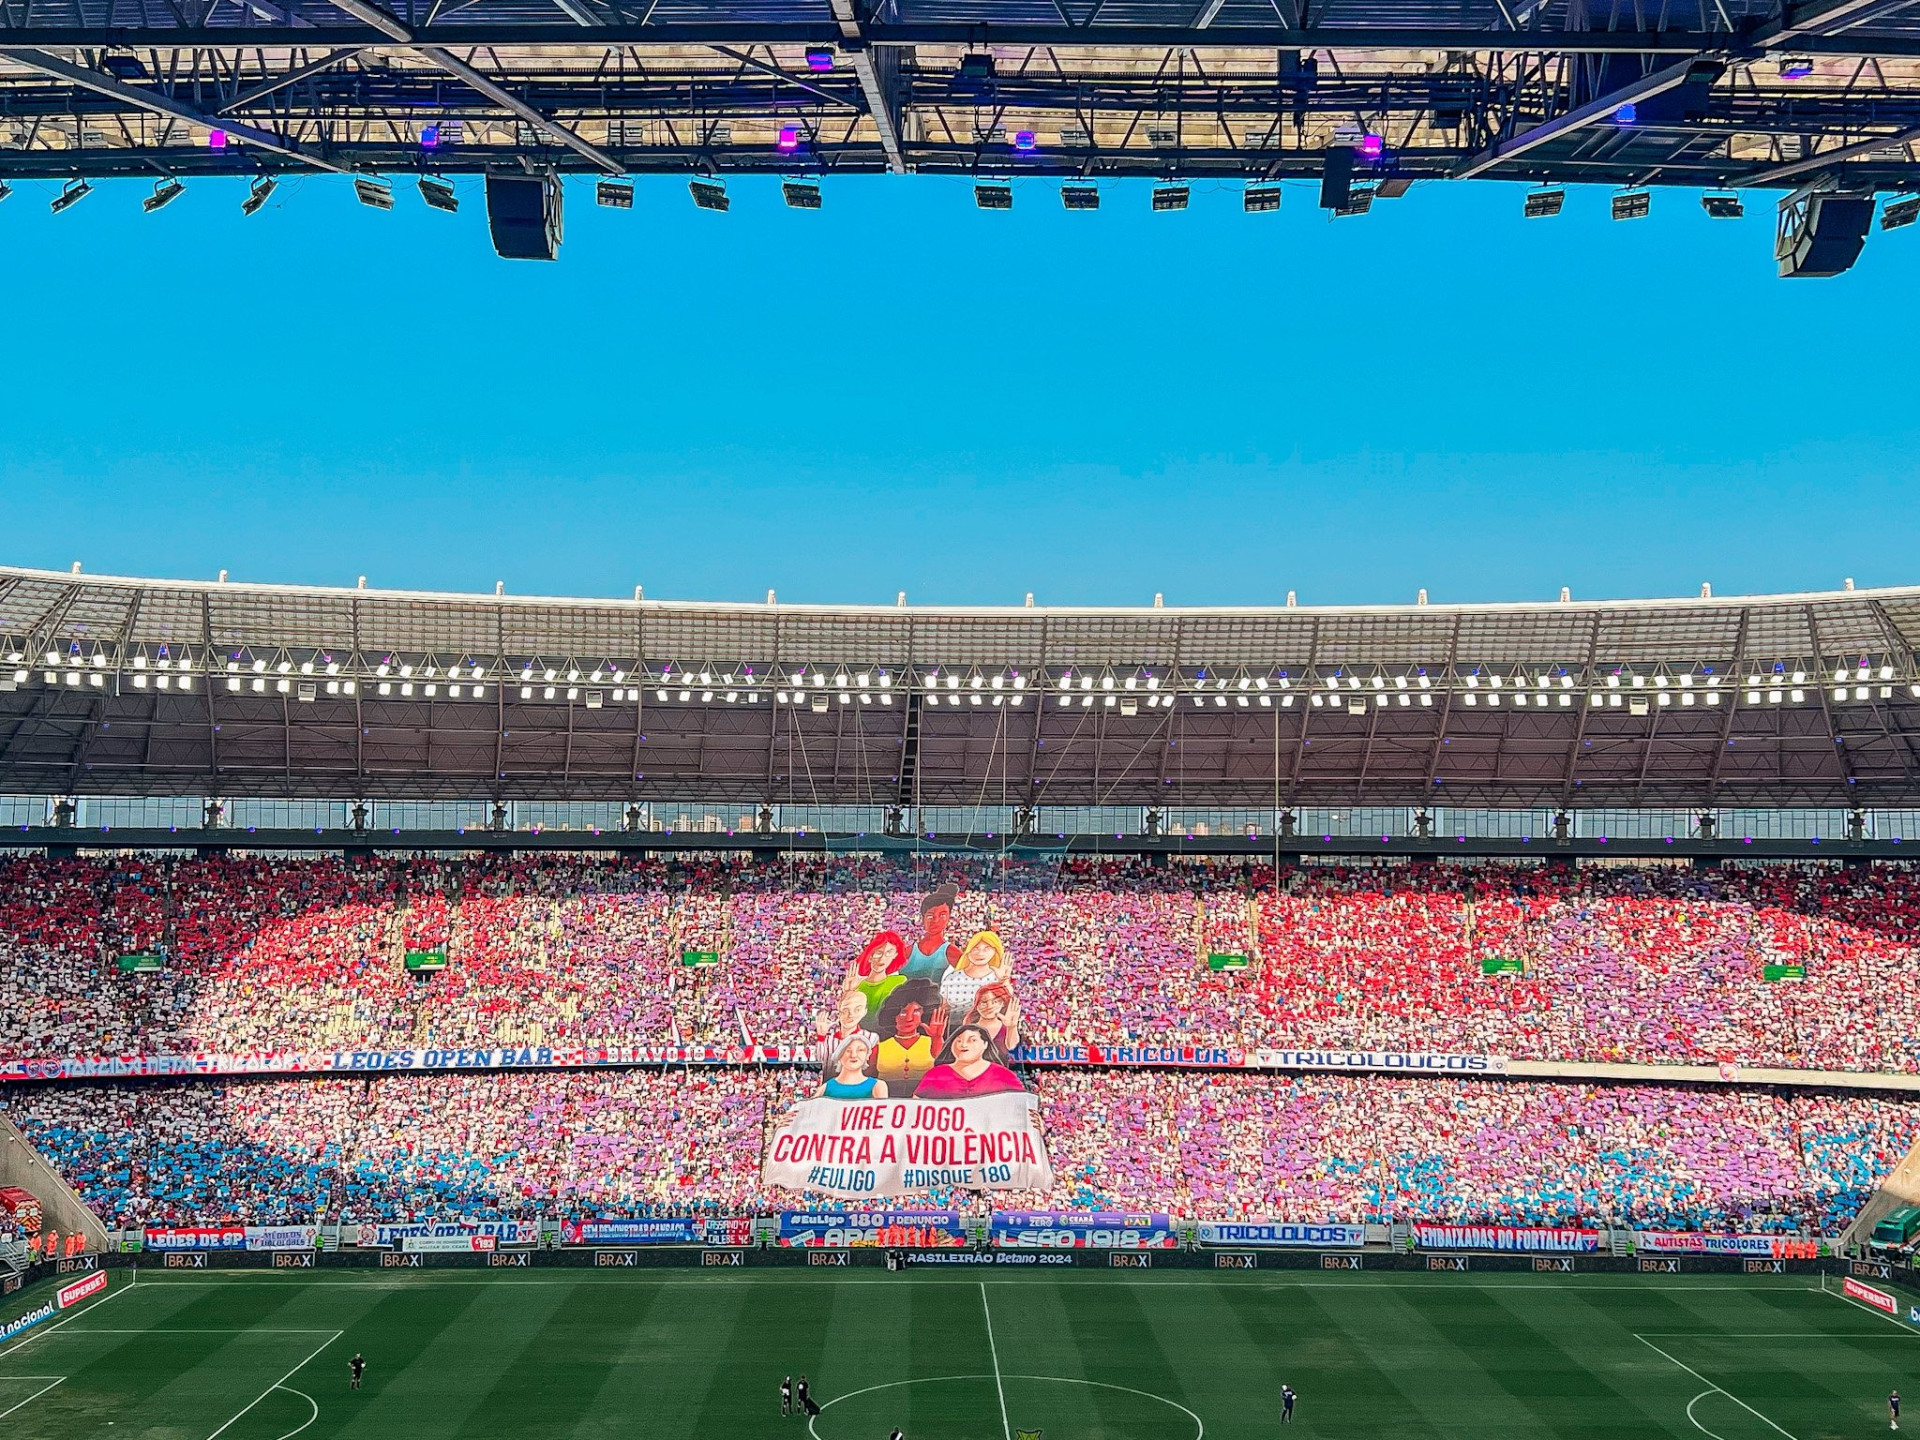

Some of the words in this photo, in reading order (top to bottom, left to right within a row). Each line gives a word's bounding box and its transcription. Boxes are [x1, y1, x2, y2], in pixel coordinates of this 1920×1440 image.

[423, 1050, 491, 1068] OPEN
[500, 1048, 553, 1066] BAR
[606, 1046, 680, 1063] BRAVO
[684, 1046, 706, 1062] 18
[1100, 1046, 1228, 1064] TRICOLOR
[1275, 1051, 1488, 1070] TRICOLOUCOS
[840, 1104, 886, 1131] VIRE
[890, 1104, 906, 1129] O
[911, 1105, 965, 1132] JOGO
[773, 1134, 871, 1164] CONTRA
[879, 1135, 897, 1163] A
[906, 1128, 1037, 1166] VIOLÊNCIA
[806, 1165, 875, 1191] #EULIGO
[903, 1168, 973, 1188] #DISQUE
[978, 1164, 1012, 1183] 180
[791, 1214, 844, 1226] #EuLigo
[849, 1213, 884, 1227] 180
[896, 1215, 949, 1225] DENUNCIO
[146, 1230, 196, 1247] LEÕES
[199, 1232, 220, 1246] DE
[223, 1232, 243, 1246] SP
[484, 1223, 518, 1241] BAR
[1000, 1229, 1076, 1247] LEÃO
[1085, 1229, 1141, 1248] 1918
[1215, 1225, 1346, 1242] TRICOLOUCOS
[480, 1238, 494, 1249] 193
[1421, 1227, 1495, 1249] EMBAIXADAS
[1498, 1229, 1513, 1249] DO
[1516, 1229, 1584, 1251] FORTALEZA
[1654, 1237, 1703, 1248] AUTISTAS
[1705, 1238, 1769, 1250] TRICOLORES
[168, 1255, 204, 1267] BRAX
[276, 1255, 311, 1267] BRAX
[384, 1255, 419, 1266] BRAX
[491, 1255, 526, 1266] BRAX
[600, 1254, 634, 1266] BRAX
[705, 1253, 740, 1266] BRAX
[812, 1253, 846, 1266] BRAX
[907, 1252, 993, 1263] RASILEIRÃO
[996, 1252, 1036, 1263] Betano
[1039, 1254, 1072, 1263] 2024
[1113, 1255, 1147, 1267] BRAX
[1219, 1256, 1253, 1268] BRAX
[1324, 1257, 1358, 1269] BRAX
[1430, 1258, 1465, 1270] BRAX
[59, 1257, 94, 1273] BRAX
[1536, 1259, 1571, 1271] BRAX
[1642, 1260, 1676, 1272] BRAX
[1748, 1261, 1782, 1273] BRAX
[1854, 1264, 1889, 1279] BRAX
[63, 1274, 106, 1302] SUPERBET
[1845, 1280, 1892, 1307] SUPERBET
